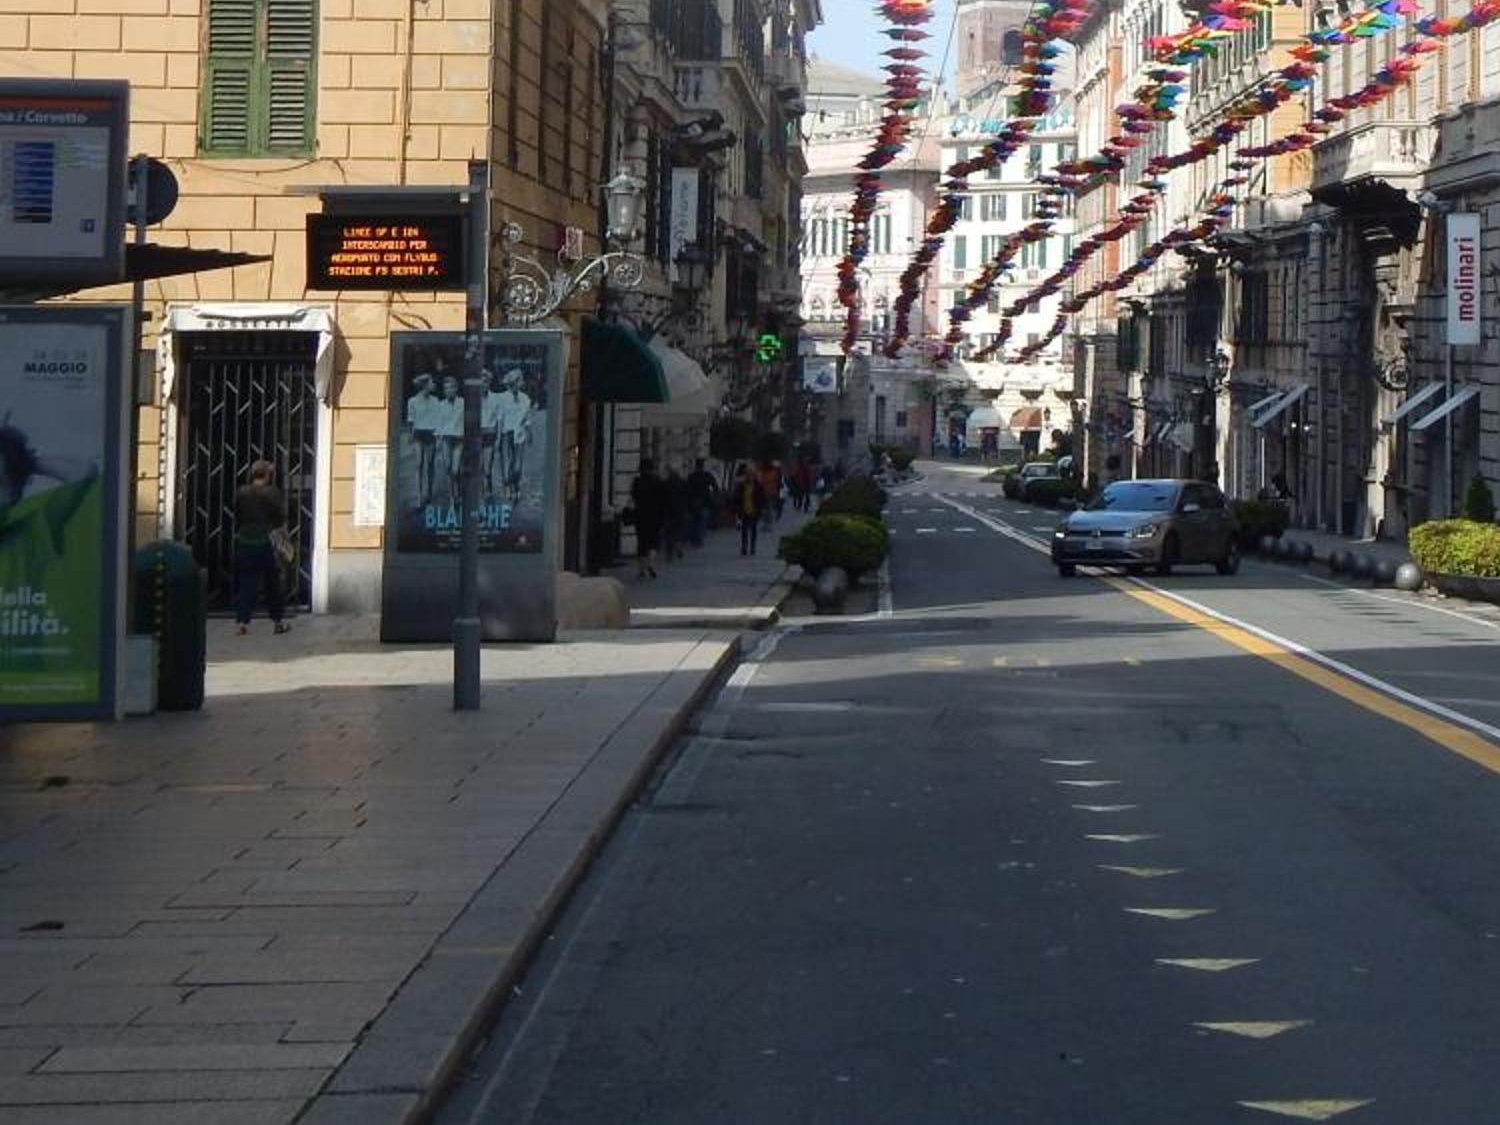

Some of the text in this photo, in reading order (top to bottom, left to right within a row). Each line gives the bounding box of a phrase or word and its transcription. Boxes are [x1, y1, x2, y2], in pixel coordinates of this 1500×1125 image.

[1454, 237, 1475, 322] molinari
[24, 362, 87, 374] MAGGIO
[424, 505, 512, 528] BLACHE
